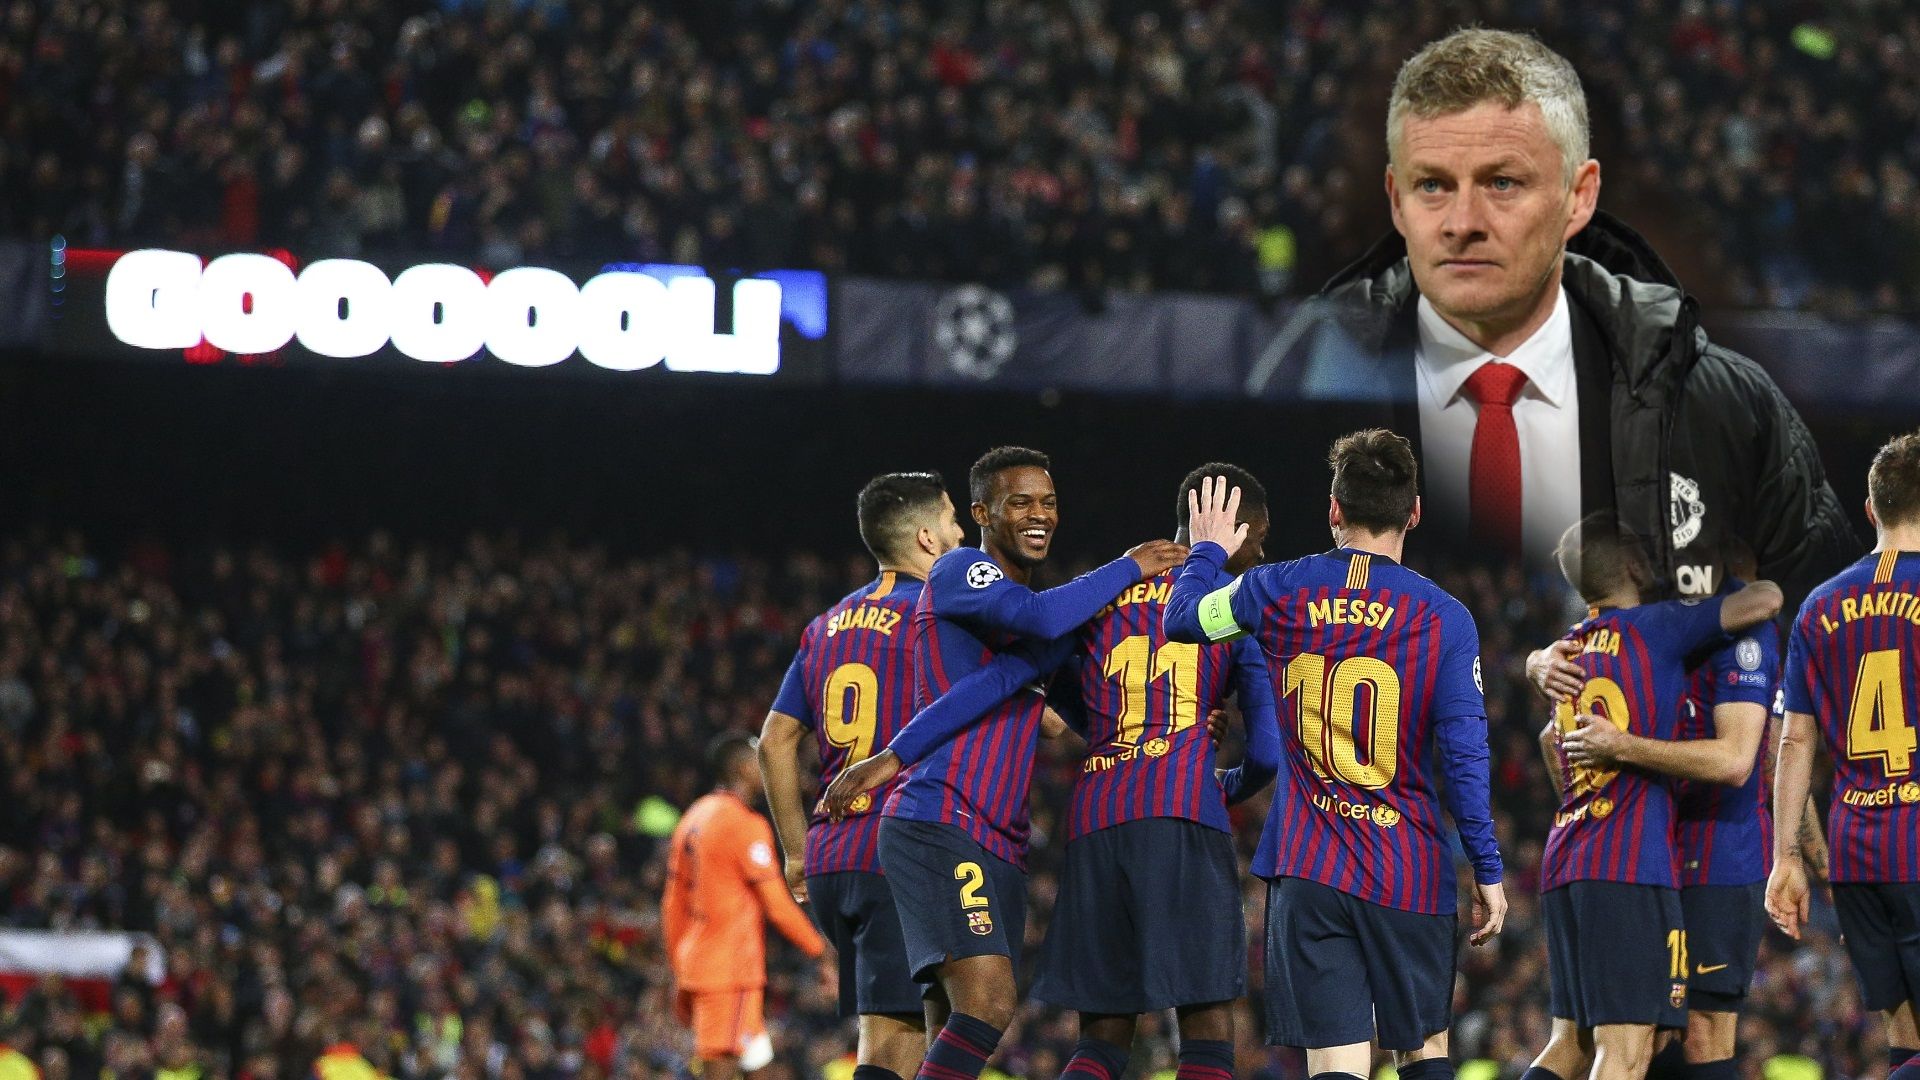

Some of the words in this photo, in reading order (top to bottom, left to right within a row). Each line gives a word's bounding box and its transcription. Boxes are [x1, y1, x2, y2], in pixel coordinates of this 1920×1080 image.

[827, 603, 902, 638] SUÁREZ
[1308, 598, 1395, 631] MESSI
[1820, 612, 1840, 635] I.
[1103, 635, 1200, 744] 11
[1847, 649, 1917, 777] 4
[823, 662, 879, 769] 9
[1282, 652, 1400, 790] 10
[1843, 782, 1897, 806] unicef
[954, 861, 989, 910] 2
